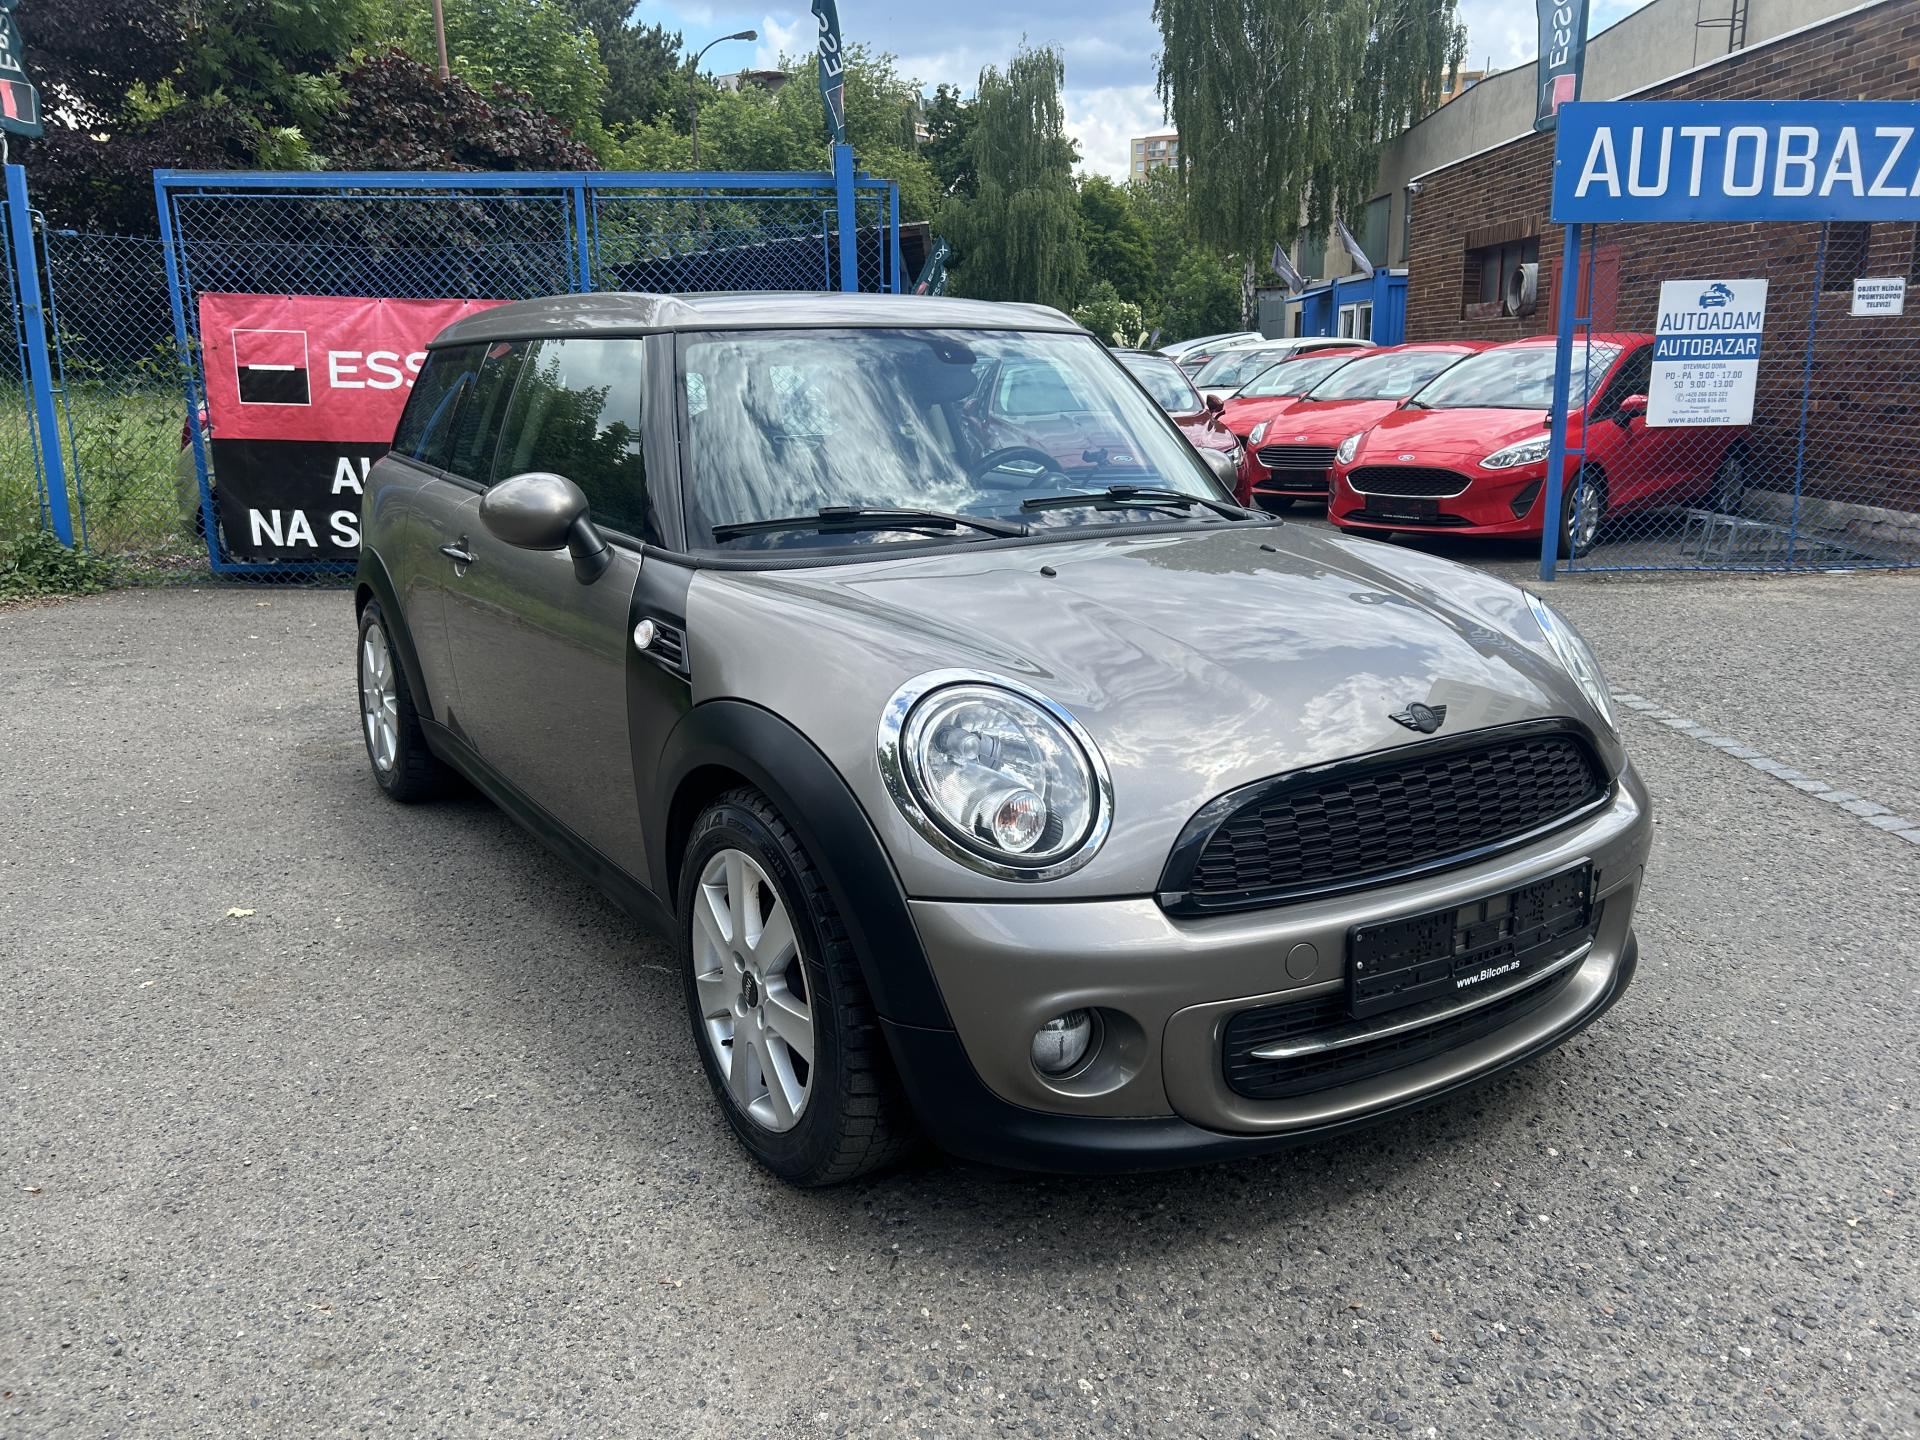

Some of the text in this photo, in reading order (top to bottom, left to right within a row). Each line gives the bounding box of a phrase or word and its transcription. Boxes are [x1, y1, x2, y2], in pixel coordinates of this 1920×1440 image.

[1661, 311, 1760, 331] AUTOADAM
[1658, 338, 1757, 357] AUTOBAZAR
[1713, 380, 1734, 388] 13.00
[1722, 371, 1742, 379] 17.00
[249, 508, 318, 547] NA
[1456, 959, 1520, 989] www.Bilcom.as
